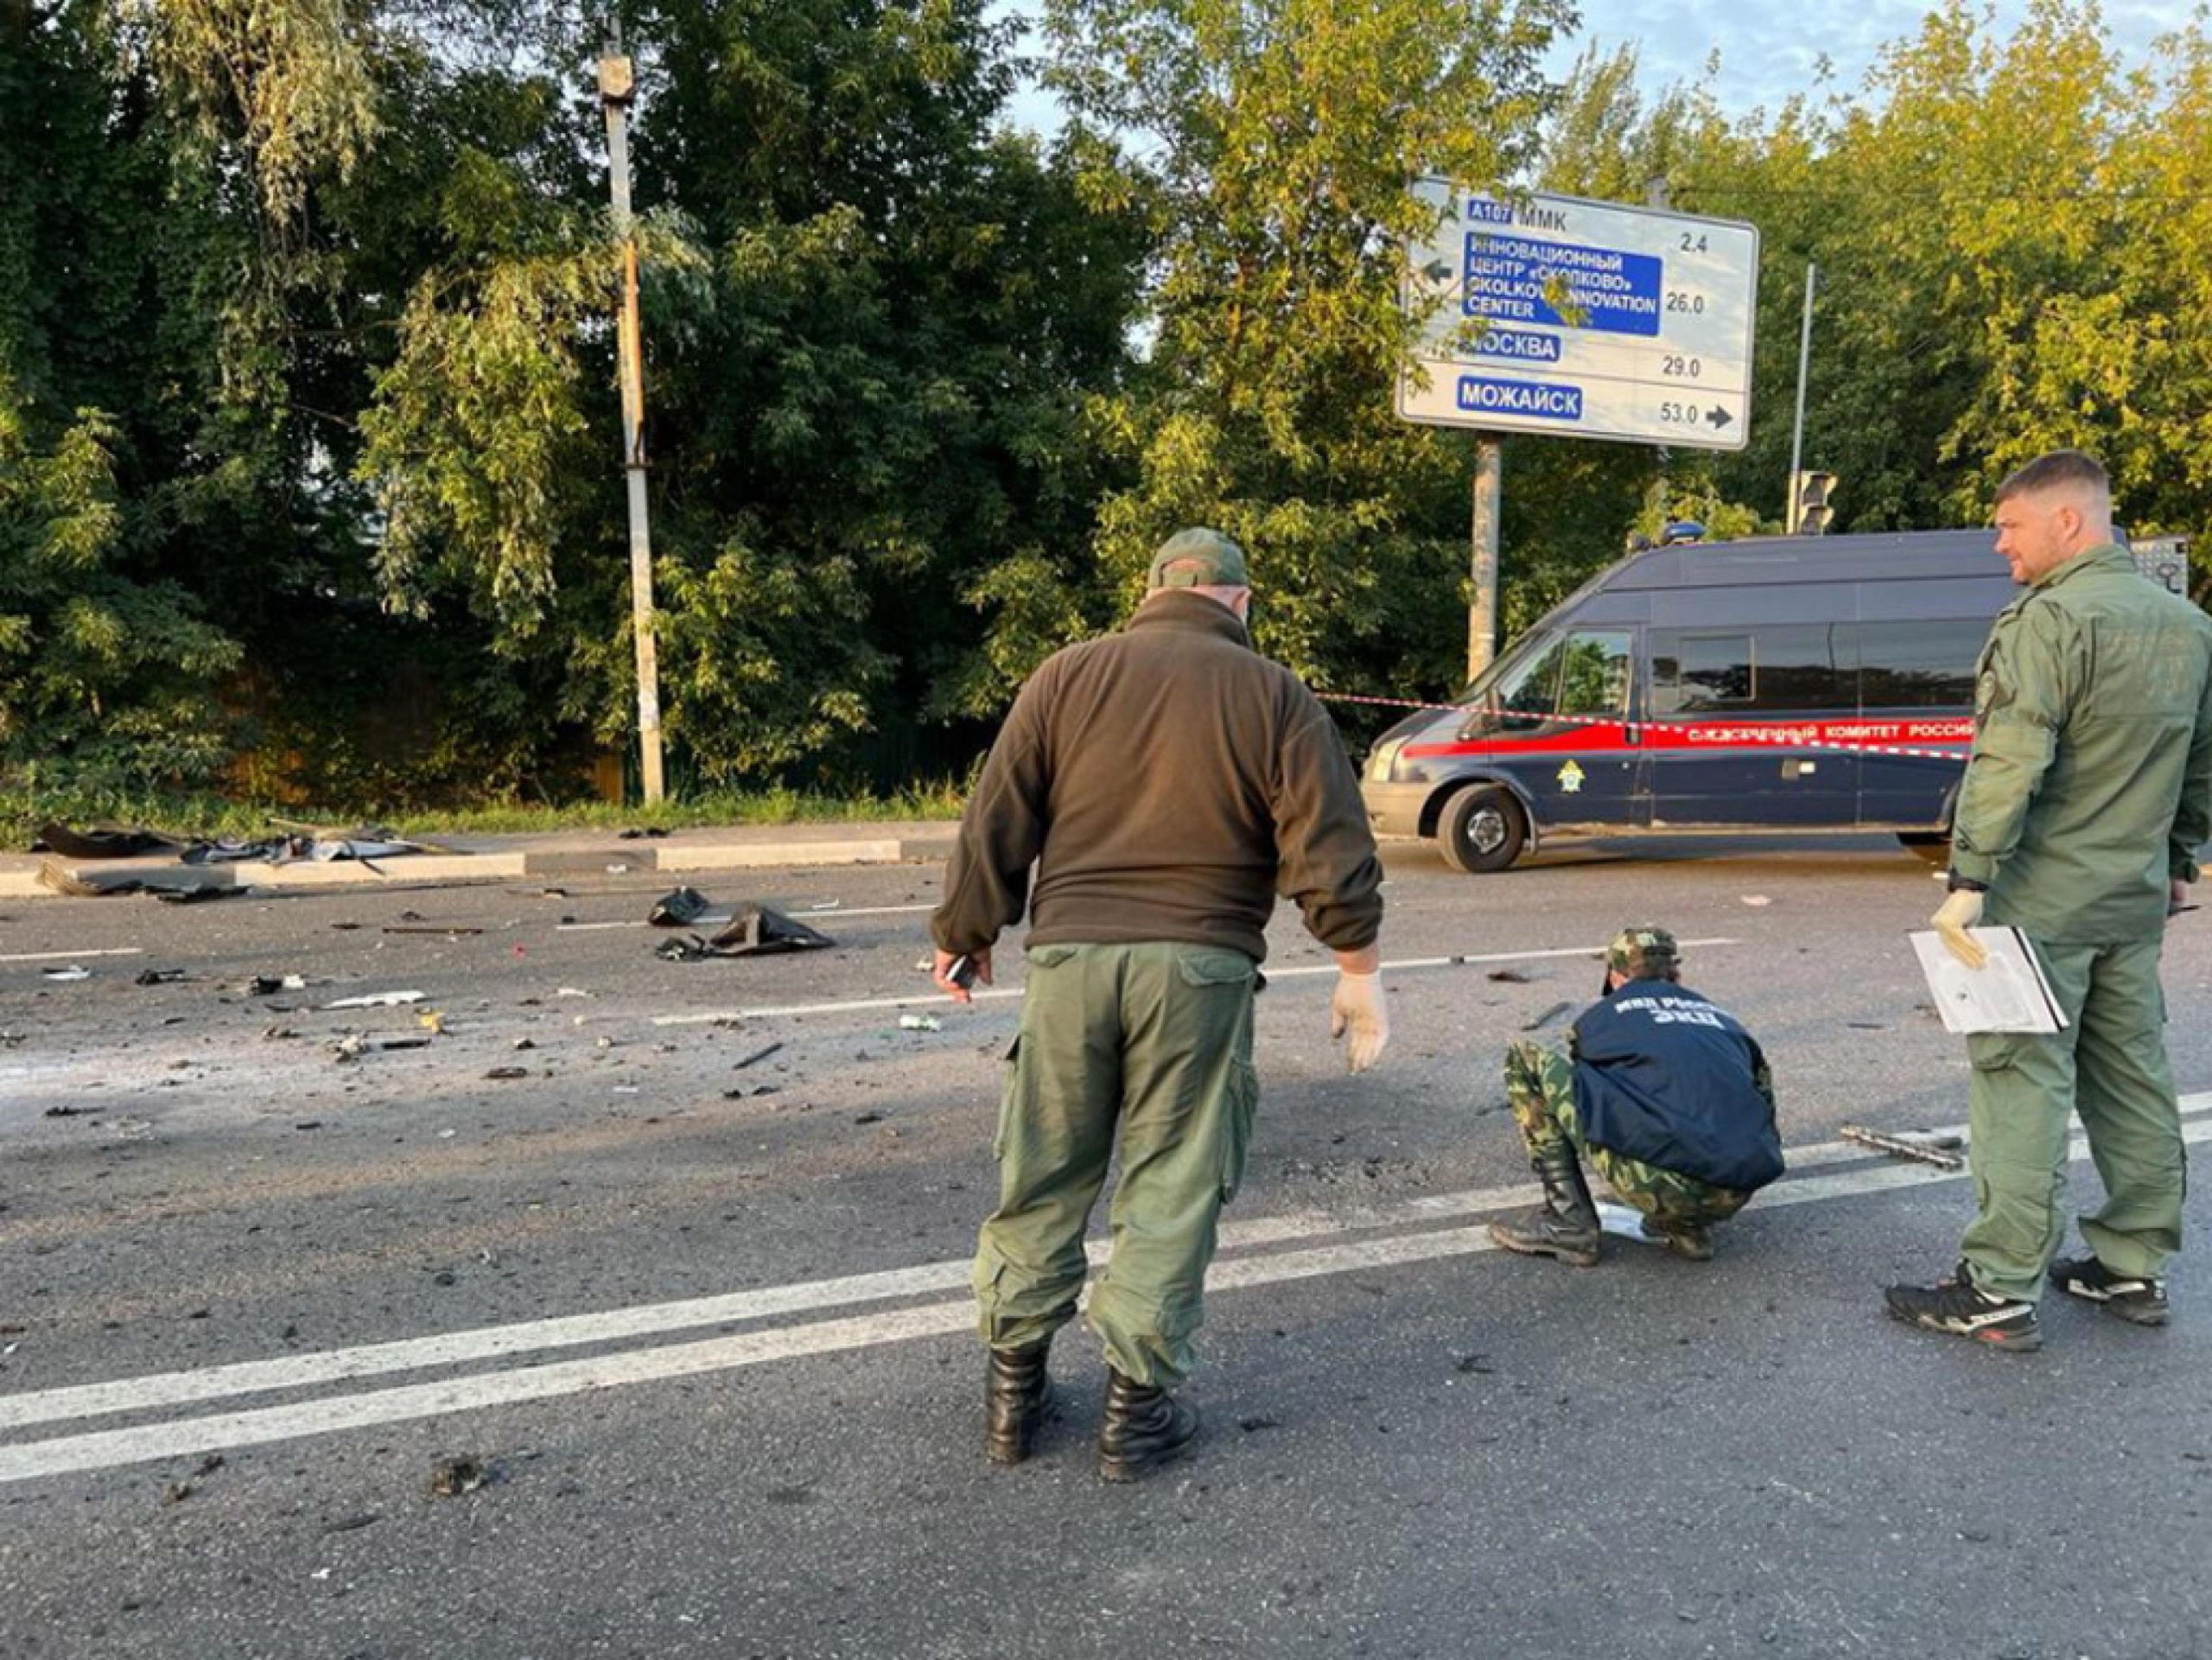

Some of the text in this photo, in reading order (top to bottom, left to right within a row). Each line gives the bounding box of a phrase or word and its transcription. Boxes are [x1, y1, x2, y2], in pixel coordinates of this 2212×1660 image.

[1471, 235, 1623, 271] ИННОВАЦИОННЫЙ
[1680, 232, 1708, 253] 2.4
[1471, 256, 1525, 277] ЦЕНТР
[1468, 296, 1535, 319] CENTER
[1665, 291, 1705, 315] 26.0
[1471, 331, 1556, 359] ОСКВА
[1662, 355, 1701, 378] 29.0
[1462, 381, 1580, 415] МОЖАЙСК
[1660, 401, 1698, 424] 53.0
[1825, 725, 1900, 739] КОМИТЕТ
